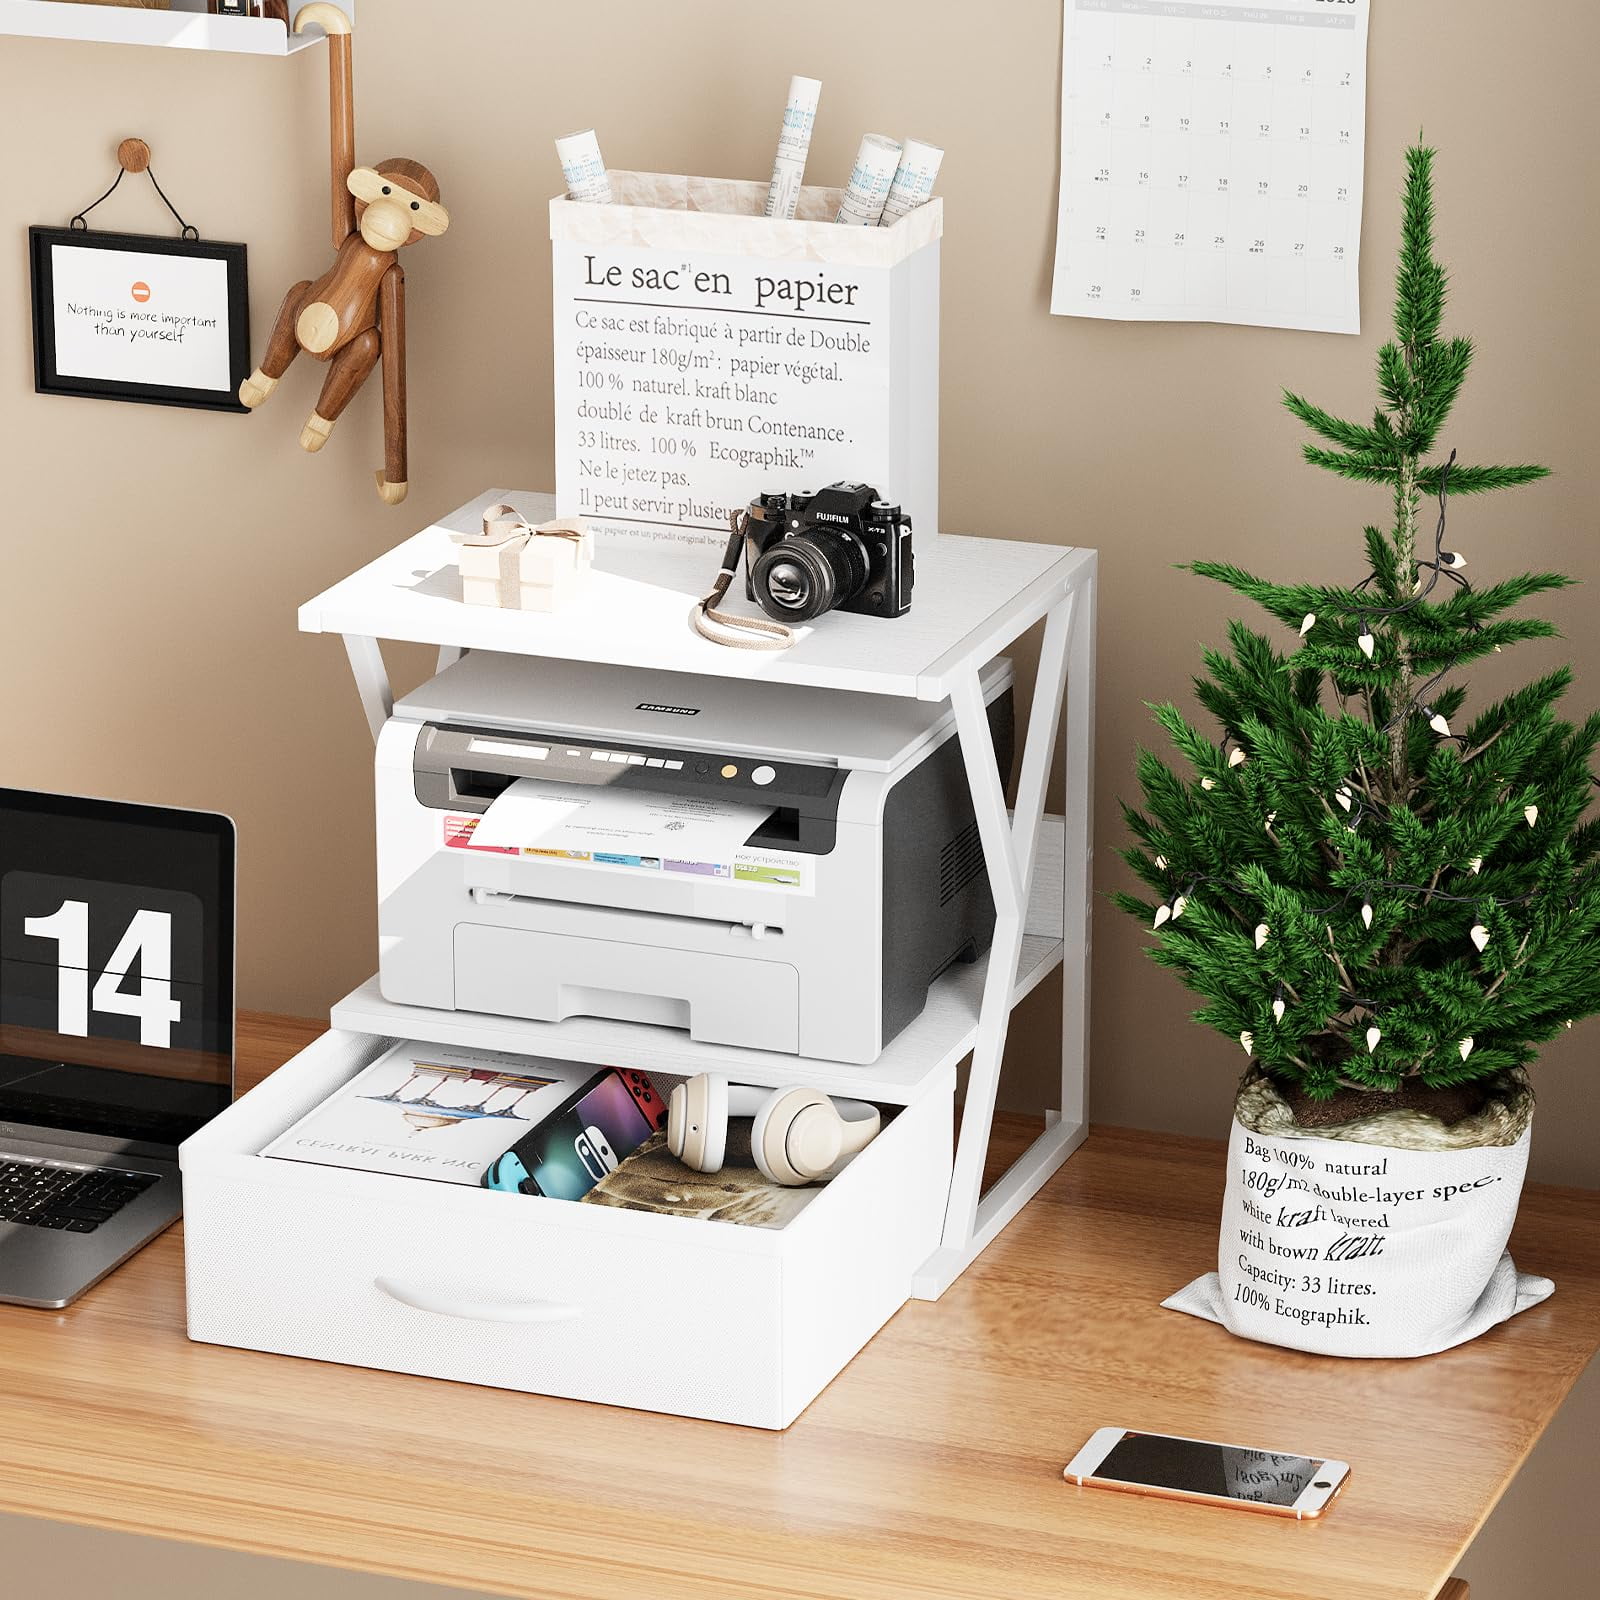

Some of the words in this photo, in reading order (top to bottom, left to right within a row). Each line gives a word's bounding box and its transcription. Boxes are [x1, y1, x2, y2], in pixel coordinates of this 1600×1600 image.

[1146, 57, 1152, 65] 2
[1219, 121, 1229, 129] 11
[1259, 124, 1270, 132] 12
[1218, 178, 1228, 186] 18
[1334, 246, 1344, 254] 28
[584, 255, 622, 287] Le
[632, 266, 680, 290] sac
[694, 272, 733, 295] en
[754, 273, 858, 311] papier
[1091, 285, 1101, 293] 29
[67, 303, 113, 323] Nothing
[117, 308, 126, 319] is
[130, 312, 157, 322] more
[161, 312, 217, 328] important
[94, 322, 125, 337] than
[130, 325, 186, 343] yourself
[575, 310, 597, 329] Ce
[601, 316, 625, 331] sac
[629, 318, 650, 333] est
[654, 316, 718, 343] fabriqué
[724, 322, 733, 339] à
[739, 325, 782, 347] partir
[786, 327, 805, 347] de
[811, 330, 871, 352] Double
[576, 342, 646, 366] épaisseur
[730, 357, 780, 378] papier
[785, 358, 843, 384] végétal.
[578, 370, 604, 390] 100
[608, 372, 624, 391] %
[633, 376, 691, 397] naturel.
[695, 379, 731, 402] kraft
[735, 382, 778, 405] blanc
[577, 402, 632, 422] doublé
[639, 404, 658, 424] de
[666, 406, 703, 428] kraft
[706, 410, 743, 431] brun
[577, 431, 596, 448] 33
[600, 432, 640, 453] litres.
[651, 436, 677, 456] 100
[681, 439, 697, 457] %
[579, 459, 602, 477] Ne
[606, 461, 618, 479] le
[621, 464, 657, 486] jetez
[661, 471, 690, 489] pas.
[580, 488, 590, 506] Il
[594, 492, 629, 512] peut
[632, 497, 674, 515] servir
[678, 498, 731, 522] plusieu
[816, 512, 849, 524] FUJIFILM
[640, 705, 696, 714] SAMSUNG
[24, 899, 181, 1049] 14
[1244, 1136, 1270, 1162] Bag
[1325, 1158, 1388, 1175] natural
[1242, 1169, 1310, 1198] 180g/m2
[1313, 1183, 1425, 1206] double-layer
[1432, 1175, 1502, 1201] spec.
[1242, 1199, 1272, 1225] white
[1276, 1205, 1328, 1228] kraft
[1330, 1208, 1390, 1229] layered
[1239, 1229, 1265, 1252] with
[1269, 1236, 1319, 1261] brown
[1238, 1254, 1296, 1293] Capacity:
[1302, 1275, 1321, 1294] 33
[1328, 1278, 1377, 1296] litres.
[1234, 1283, 1270, 1312] 100%
[1275, 1298, 1370, 1329] Ecographik.
